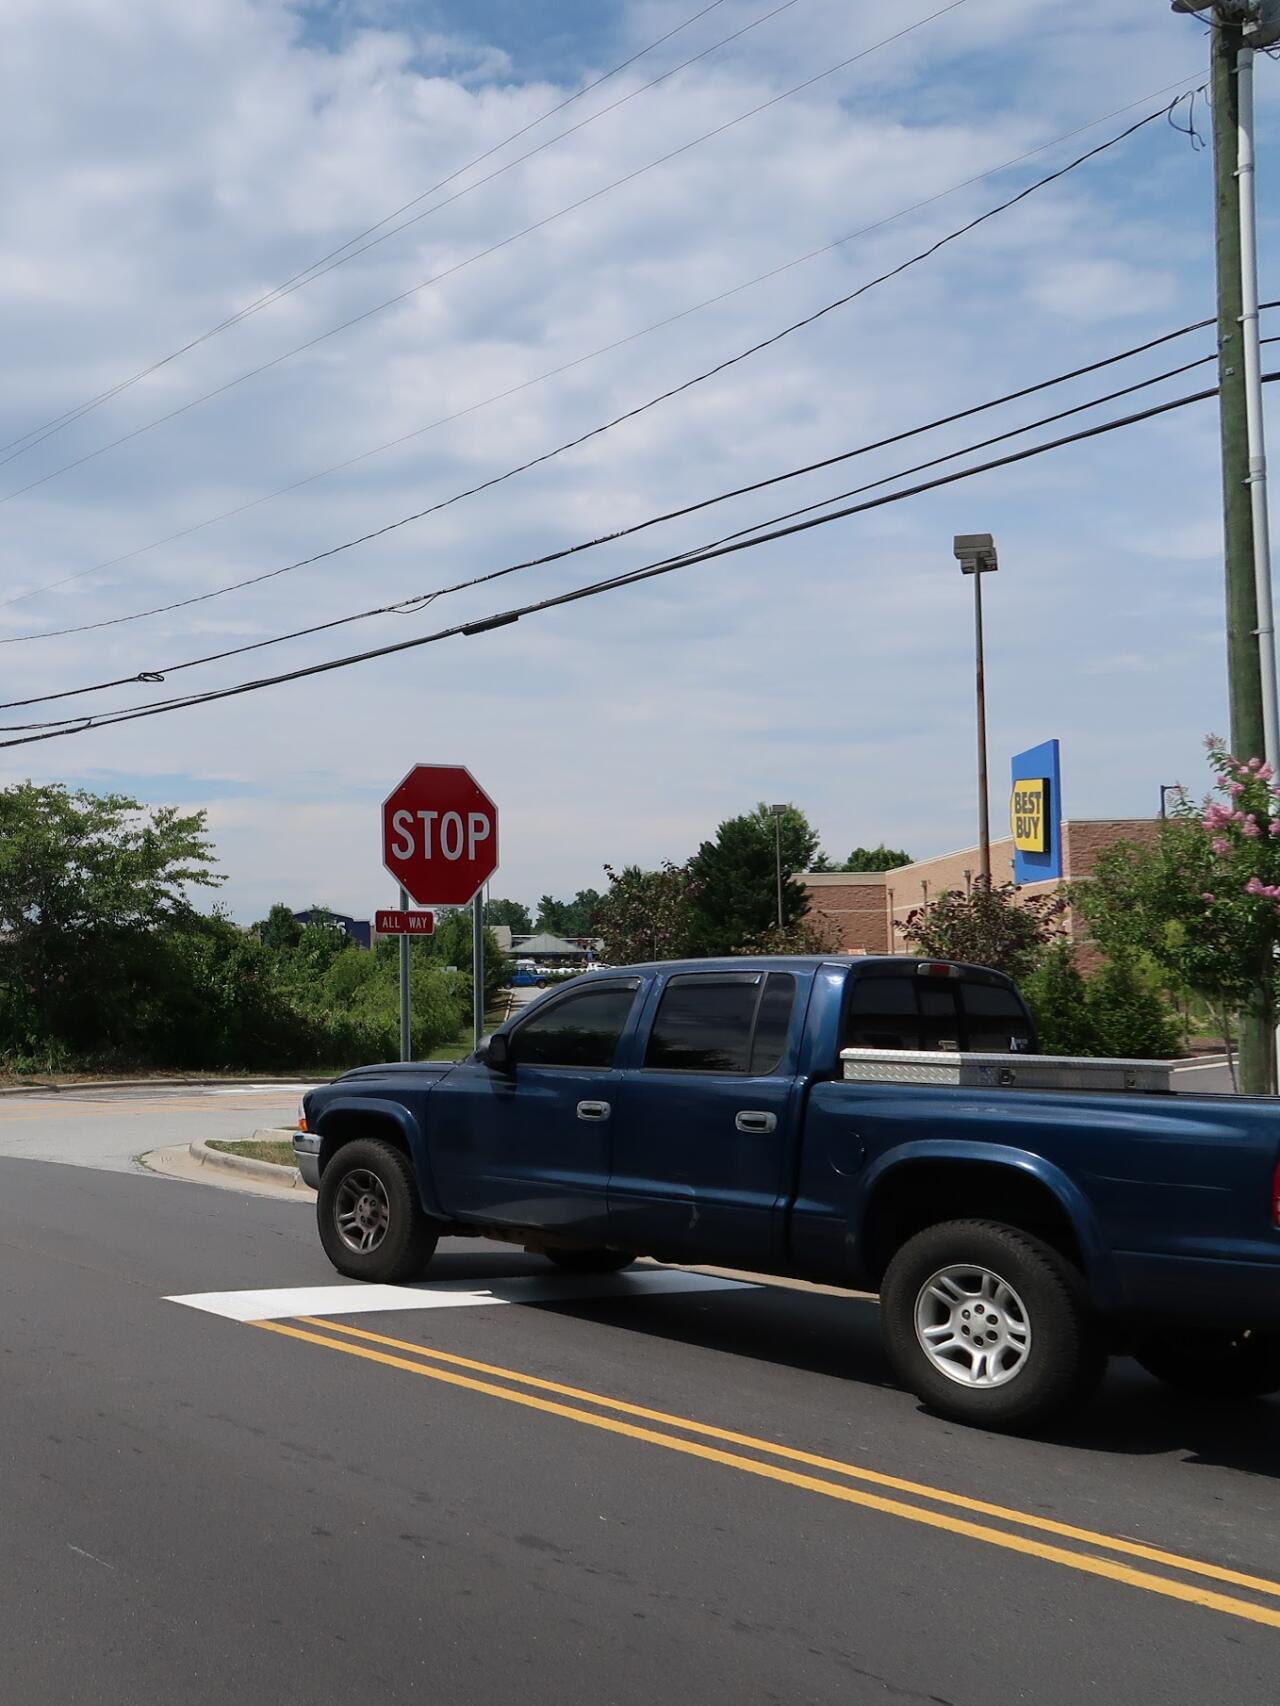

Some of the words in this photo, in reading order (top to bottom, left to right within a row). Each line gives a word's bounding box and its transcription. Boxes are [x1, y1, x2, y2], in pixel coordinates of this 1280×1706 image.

[1014, 791, 1041, 814] BEST
[391, 809, 490, 861] STOP
[1016, 816, 1040, 839] BUY
[382, 916, 400, 929] ALL
[408, 916, 427, 929] WAY
